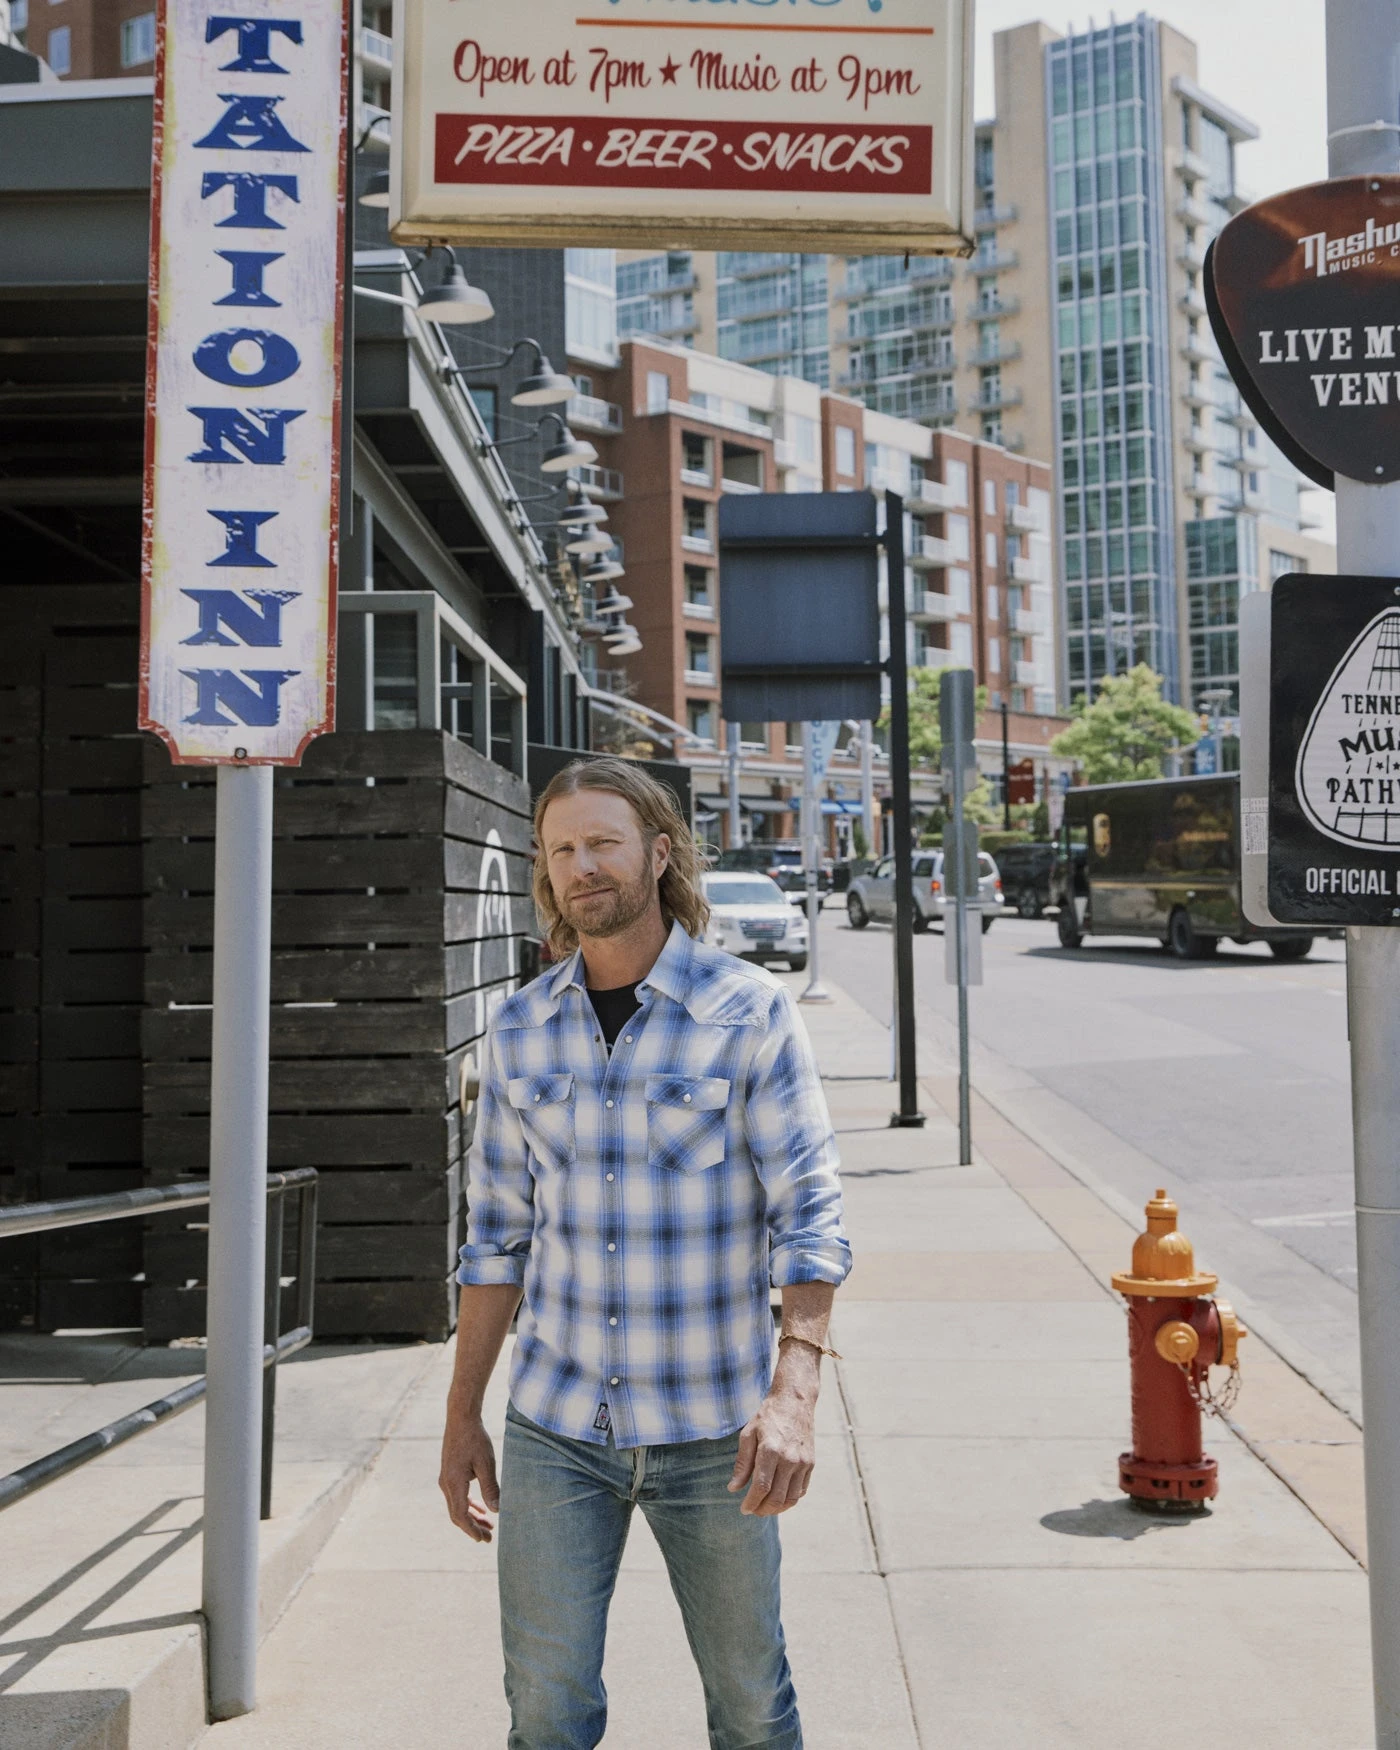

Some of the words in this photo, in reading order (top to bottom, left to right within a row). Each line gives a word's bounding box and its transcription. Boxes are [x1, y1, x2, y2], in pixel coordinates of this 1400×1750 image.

[454, 40, 535, 98] Open
[543, 50, 576, 88] at
[588, 48, 651, 103] 7pm
[690, 50, 780, 93] Music
[791, 57, 826, 93] at
[838, 55, 920, 110] 9pm
[455, 124, 574, 167] PIZZA
[596, 129, 717, 170] BEER
[734, 132, 909, 174] SNACKS
[1329, 251, 1376, 274] MUSIC
[1258, 327, 1352, 364] LIVE
[1363, 325, 1400, 359] M
[1310, 371, 1400, 407] VEN
[178, 509, 303, 727] INN
[1338, 727, 1400, 762] MU
[1326, 777, 1400, 804] PATH
[1305, 867, 1392, 895] OFFICIAL
